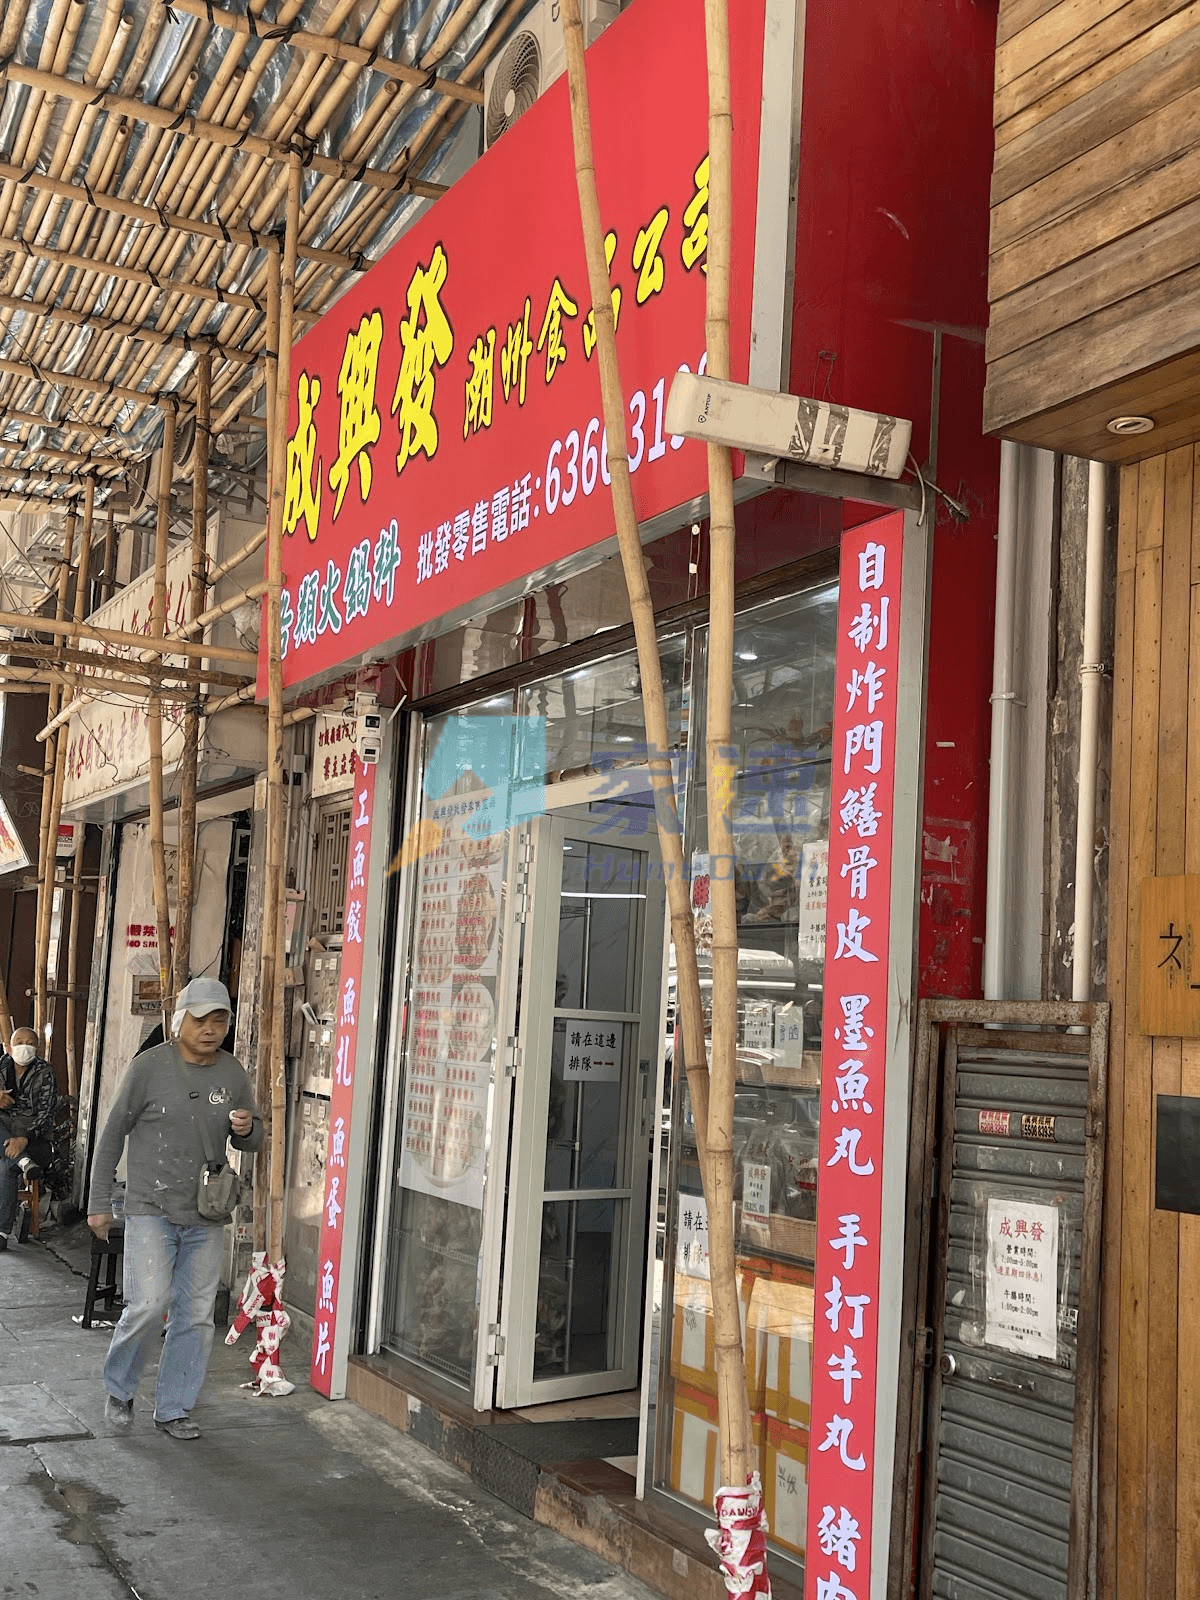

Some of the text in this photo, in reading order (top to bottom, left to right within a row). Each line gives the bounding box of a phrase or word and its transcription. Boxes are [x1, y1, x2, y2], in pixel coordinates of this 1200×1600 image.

[283, 243, 453, 541] 成興發
[568, 1055, 592, 1071] 排隊
[571, 1031, 616, 1049] 請在這邊
[826, 995, 875, 1177] 墨魚丸
[326, 1117, 345, 1230] 魚蛋
[683, 1210, 708, 1231] 請在
[999, 1217, 1046, 1242] 成興發
[315, 1259, 334, 1376] 魚片
[818, 1213, 872, 1472] 手打牛丸
